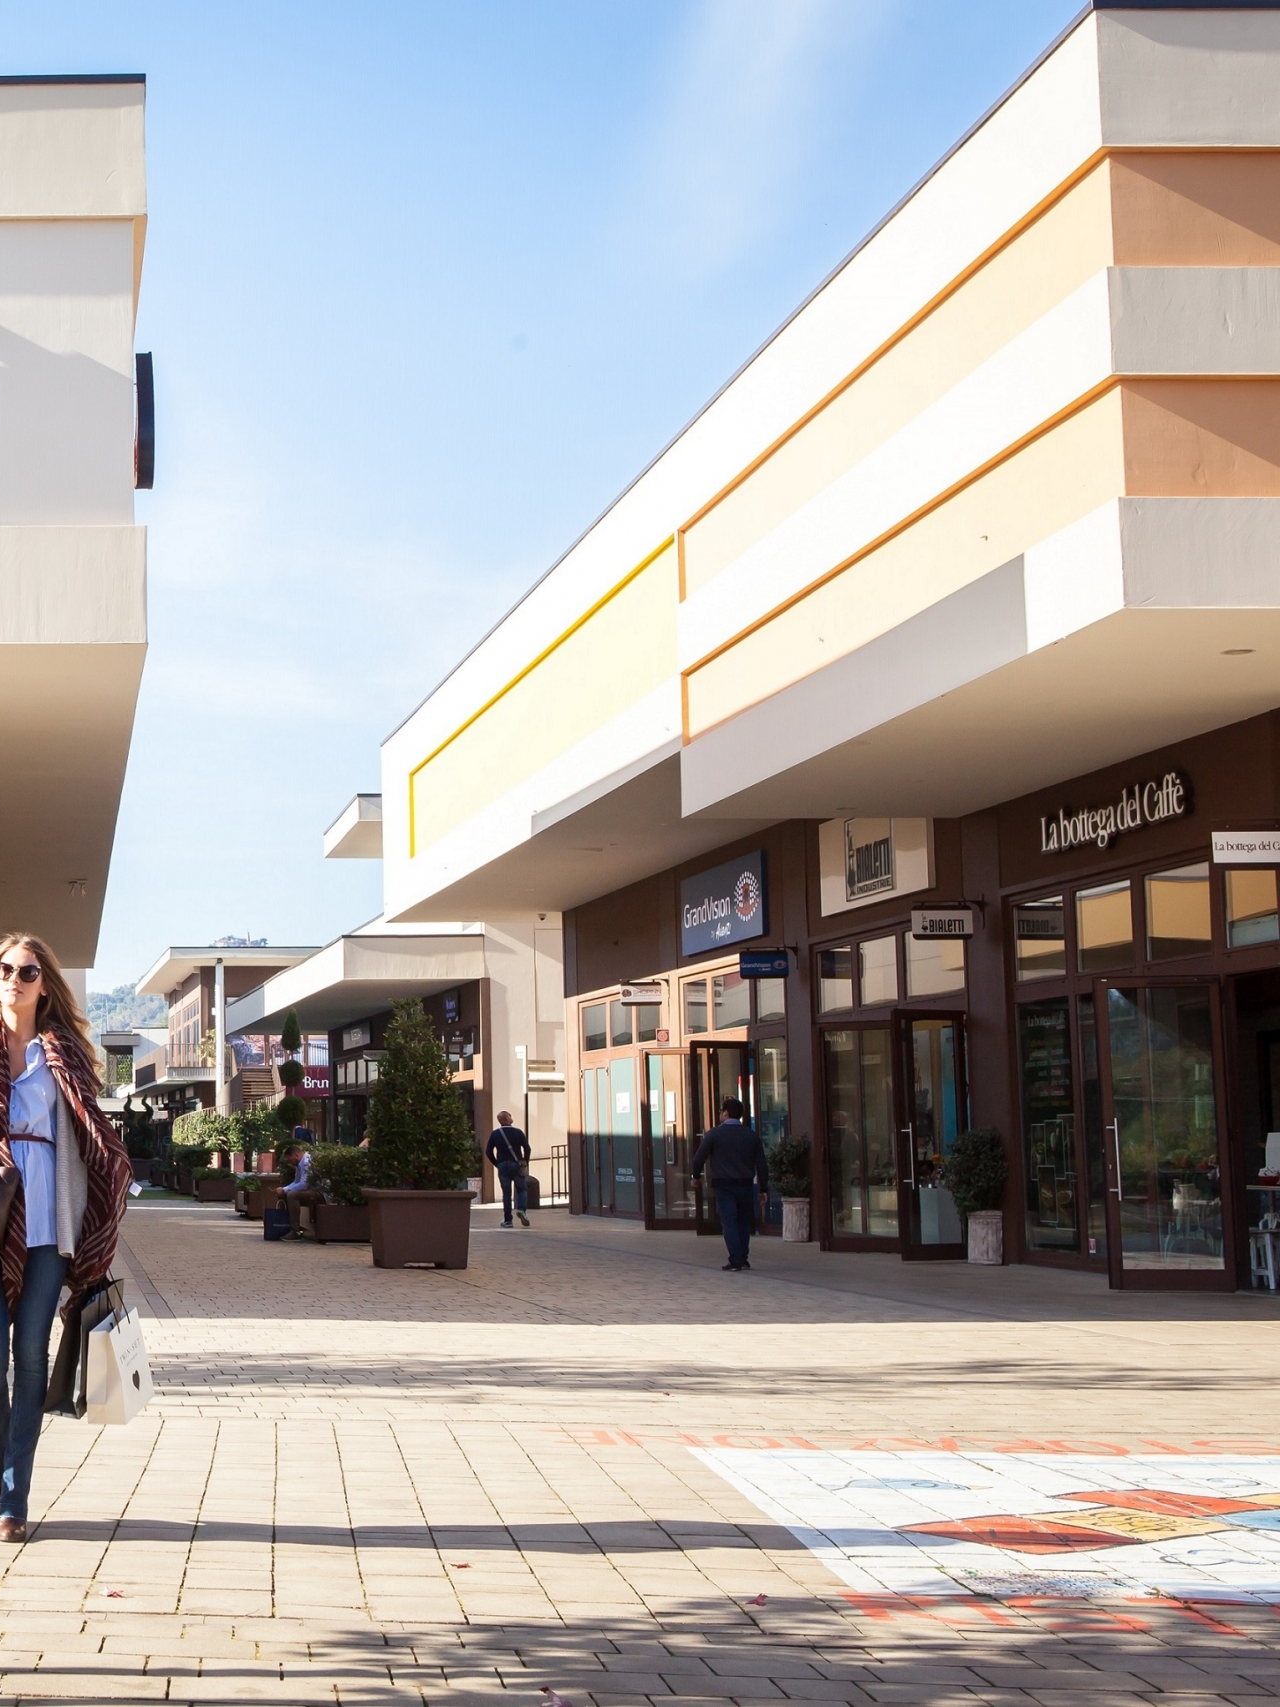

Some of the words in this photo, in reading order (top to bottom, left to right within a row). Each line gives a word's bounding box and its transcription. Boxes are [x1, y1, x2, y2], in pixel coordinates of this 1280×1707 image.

[1040, 817, 1058, 851] La
[1059, 808, 1116, 847] bottega
[1117, 784, 1141, 830] del
[1215, 842, 1224, 851] La
[1226, 841, 1256, 853] bottega
[1259, 841, 1271, 851] del
[856, 877, 891, 894] INDUSTRIE
[683, 896, 731, 929] GrandVision
[837, 1590, 1280, 1638] RIST
